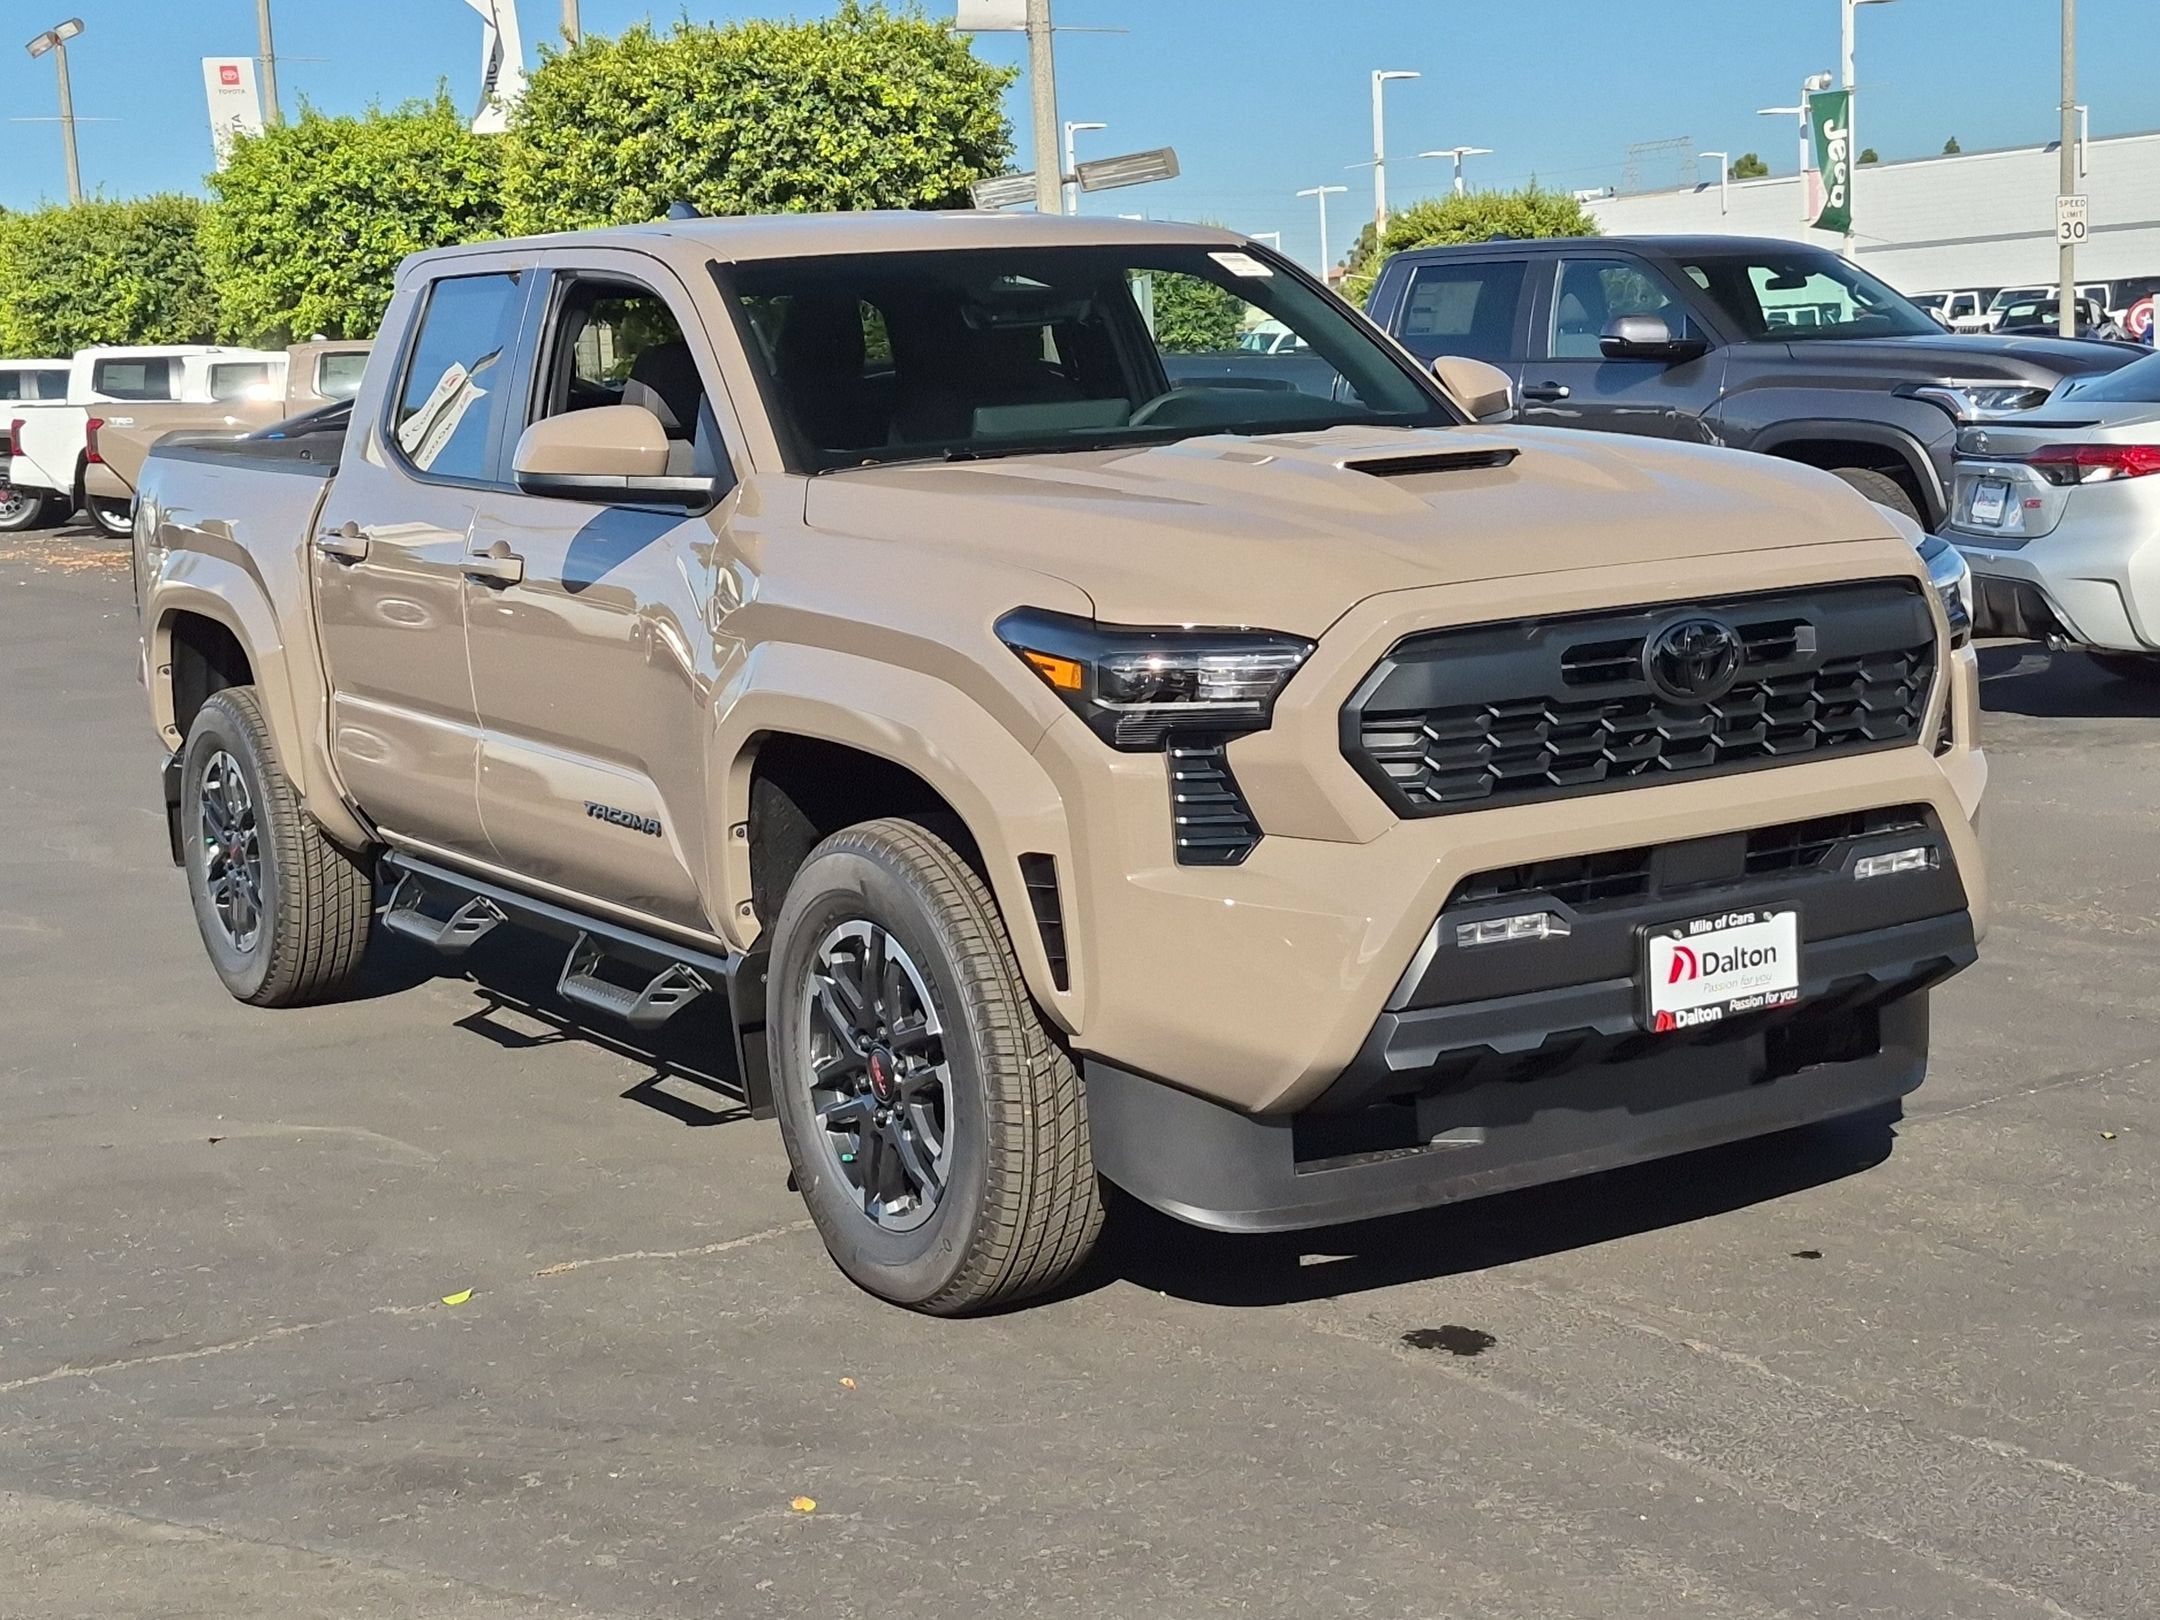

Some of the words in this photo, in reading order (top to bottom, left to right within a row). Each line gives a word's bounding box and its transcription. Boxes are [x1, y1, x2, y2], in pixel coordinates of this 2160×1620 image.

[1823, 119, 1848, 208] Jeep
[2058, 199, 2086, 208] SPEED
[2062, 210, 2083, 219] LIMIT
[2060, 221, 2085, 240] 30
[584, 800, 662, 838] TACOMA
[1689, 920, 1713, 934] Mile
[1715, 915, 1728, 929] of
[1728, 912, 1756, 927] Cars
[1702, 945, 1777, 977] Dalton
[1703, 978, 1739, 994] Passion
[1740, 975, 1754, 987] for
[1755, 973, 1773, 986] you
[1729, 996, 1764, 1012] Passion
[1764, 991, 1779, 1005] for
[1779, 989, 1798, 1005] you
[1675, 1006, 1722, 1029] Dalton
